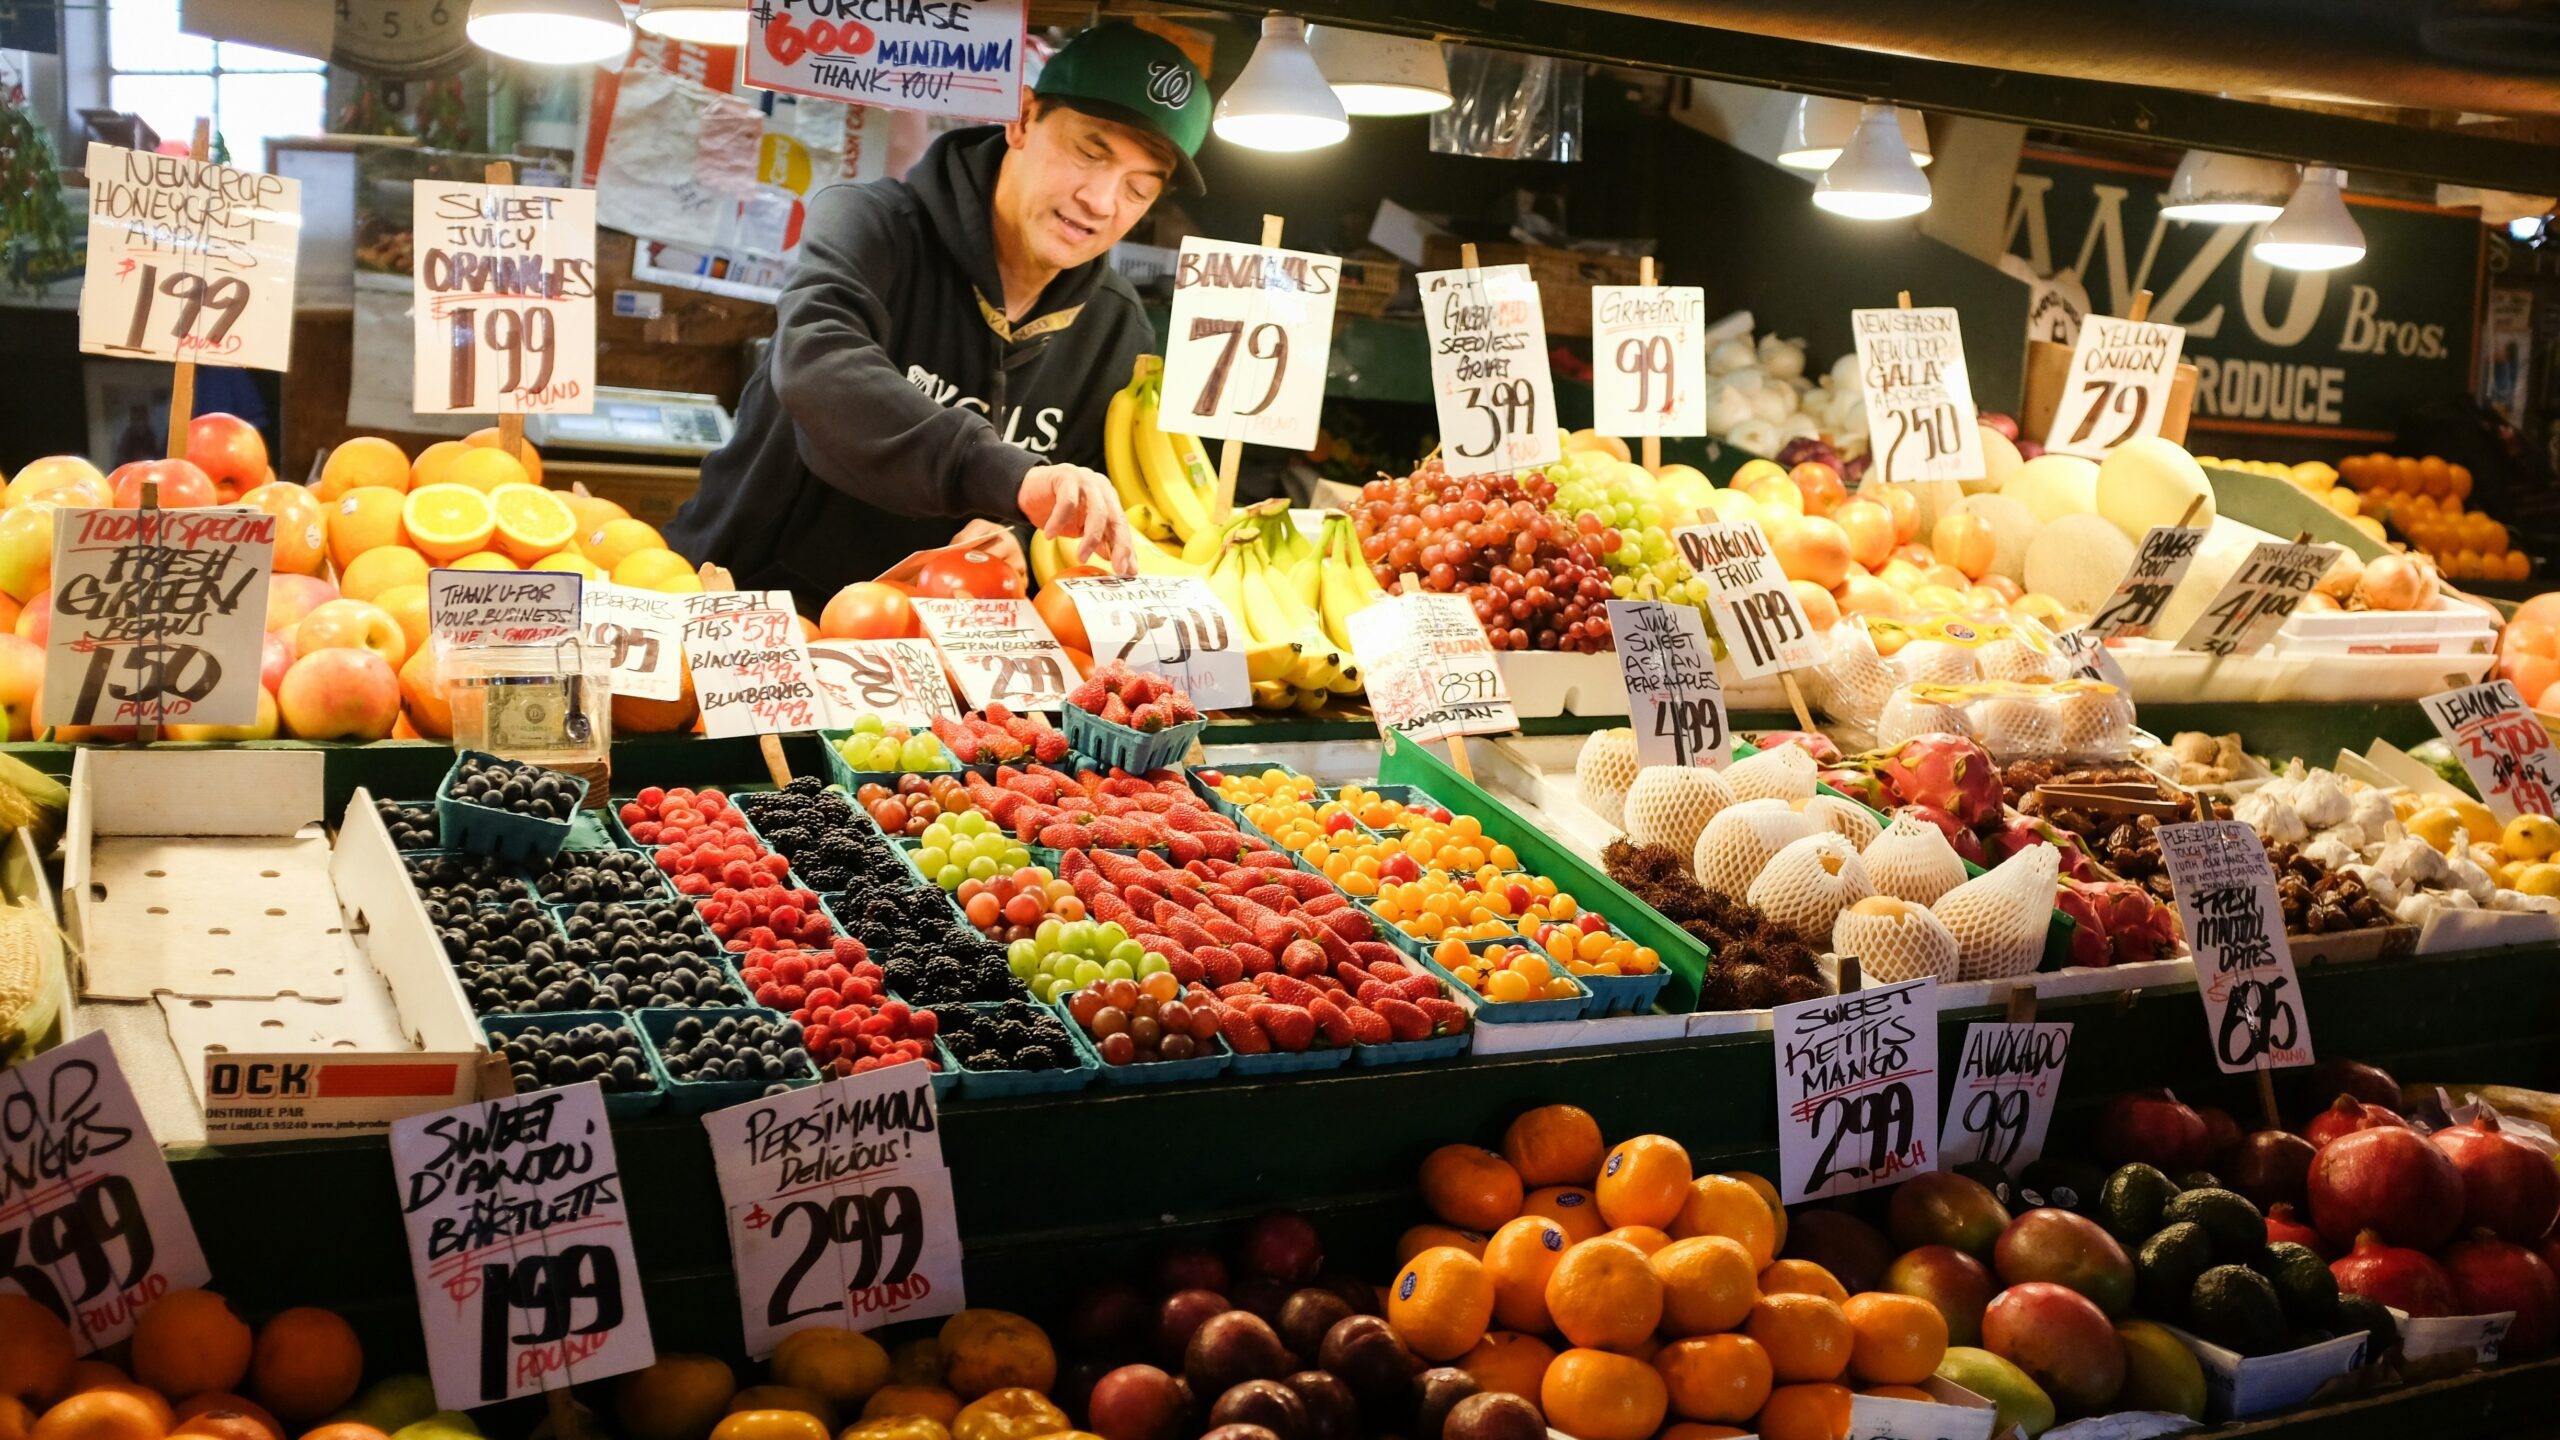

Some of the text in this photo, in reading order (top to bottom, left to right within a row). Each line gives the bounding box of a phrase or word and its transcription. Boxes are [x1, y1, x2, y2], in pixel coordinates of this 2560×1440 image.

[383, 11, 400, 38] 5
[431, 0, 449, 26] 6
[877, 39, 1013, 73] MINIMUM
[809, 63, 954, 103] THANK YOU!
[436, 193, 563, 222] SWEET
[447, 224, 536, 251] JUICY
[2338, 284, 2449, 360] Bros.
[2084, 348, 2167, 376] ONION
[513, 379, 580, 411] POUND
[2180, 354, 2346, 425] RODUCE
[2068, 380, 2150, 449] 79
[1679, 524, 1766, 573] DRAGON
[1711, 558, 1765, 591] FRUIT
[440, 583, 498, 607] THANK
[684, 594, 771, 615] FRESH
[682, 619, 733, 642] FIGS
[1438, 668, 1497, 704] 899
[114, 700, 192, 722] POUND
[1795, 983, 1926, 1035] SWEET
[1963, 1027, 2070, 1079] AVOCADO
[1802, 1045, 1909, 1100] MANGO
[278, 1106, 304, 1118] PAR
[424, 1094, 563, 1170] SWEET
[851, 1272, 931, 1318] POUND
